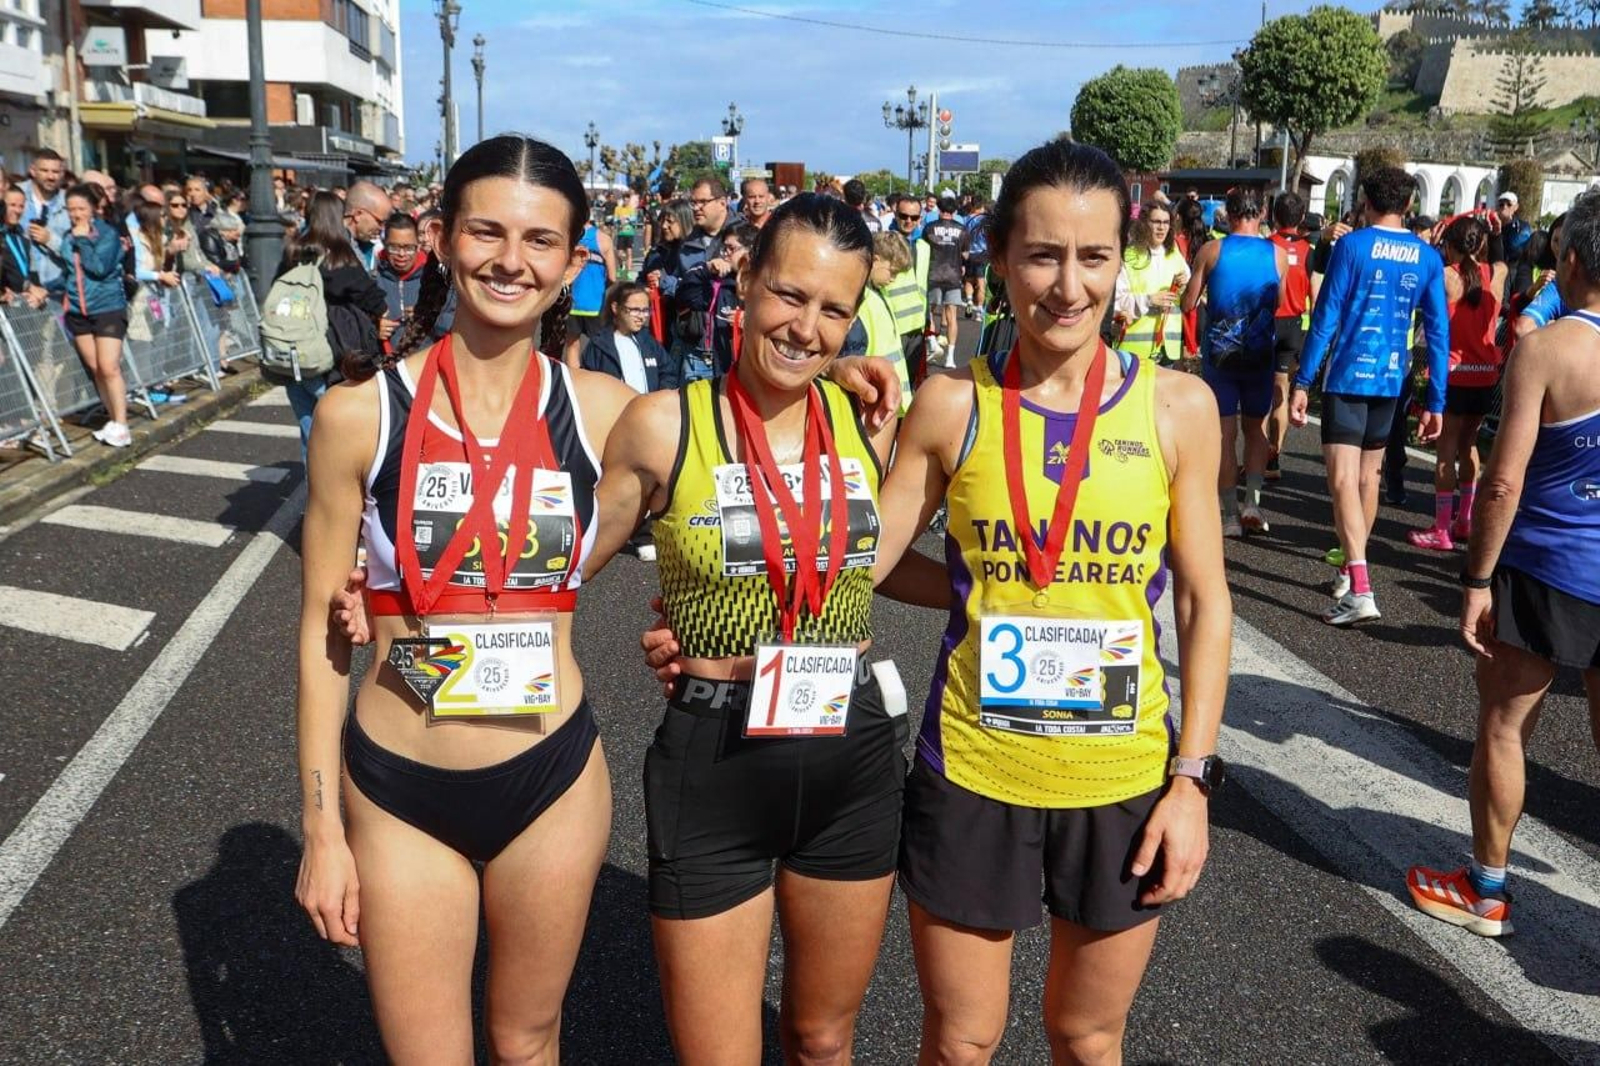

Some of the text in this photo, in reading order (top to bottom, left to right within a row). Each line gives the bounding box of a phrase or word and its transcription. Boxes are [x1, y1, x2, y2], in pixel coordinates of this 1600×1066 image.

[1371, 242, 1420, 264] GANDIA
[426, 476, 447, 498] 25
[971, 518, 1152, 556] TANNOS
[982, 560, 1145, 585] PONEAREAS
[436, 633, 478, 703] 2
[475, 631, 551, 650] CLASIFICADA
[987, 623, 1027, 693] 3
[1025, 626, 1100, 644] CLASIFICADA
[1039, 660, 1056, 675] 25
[483, 667, 501, 684] 25
[760, 650, 784, 726] 1
[786, 656, 853, 674] CLASIFICADA
[795, 688, 810, 705] 25
[1042, 709, 1074, 720] SONIA
